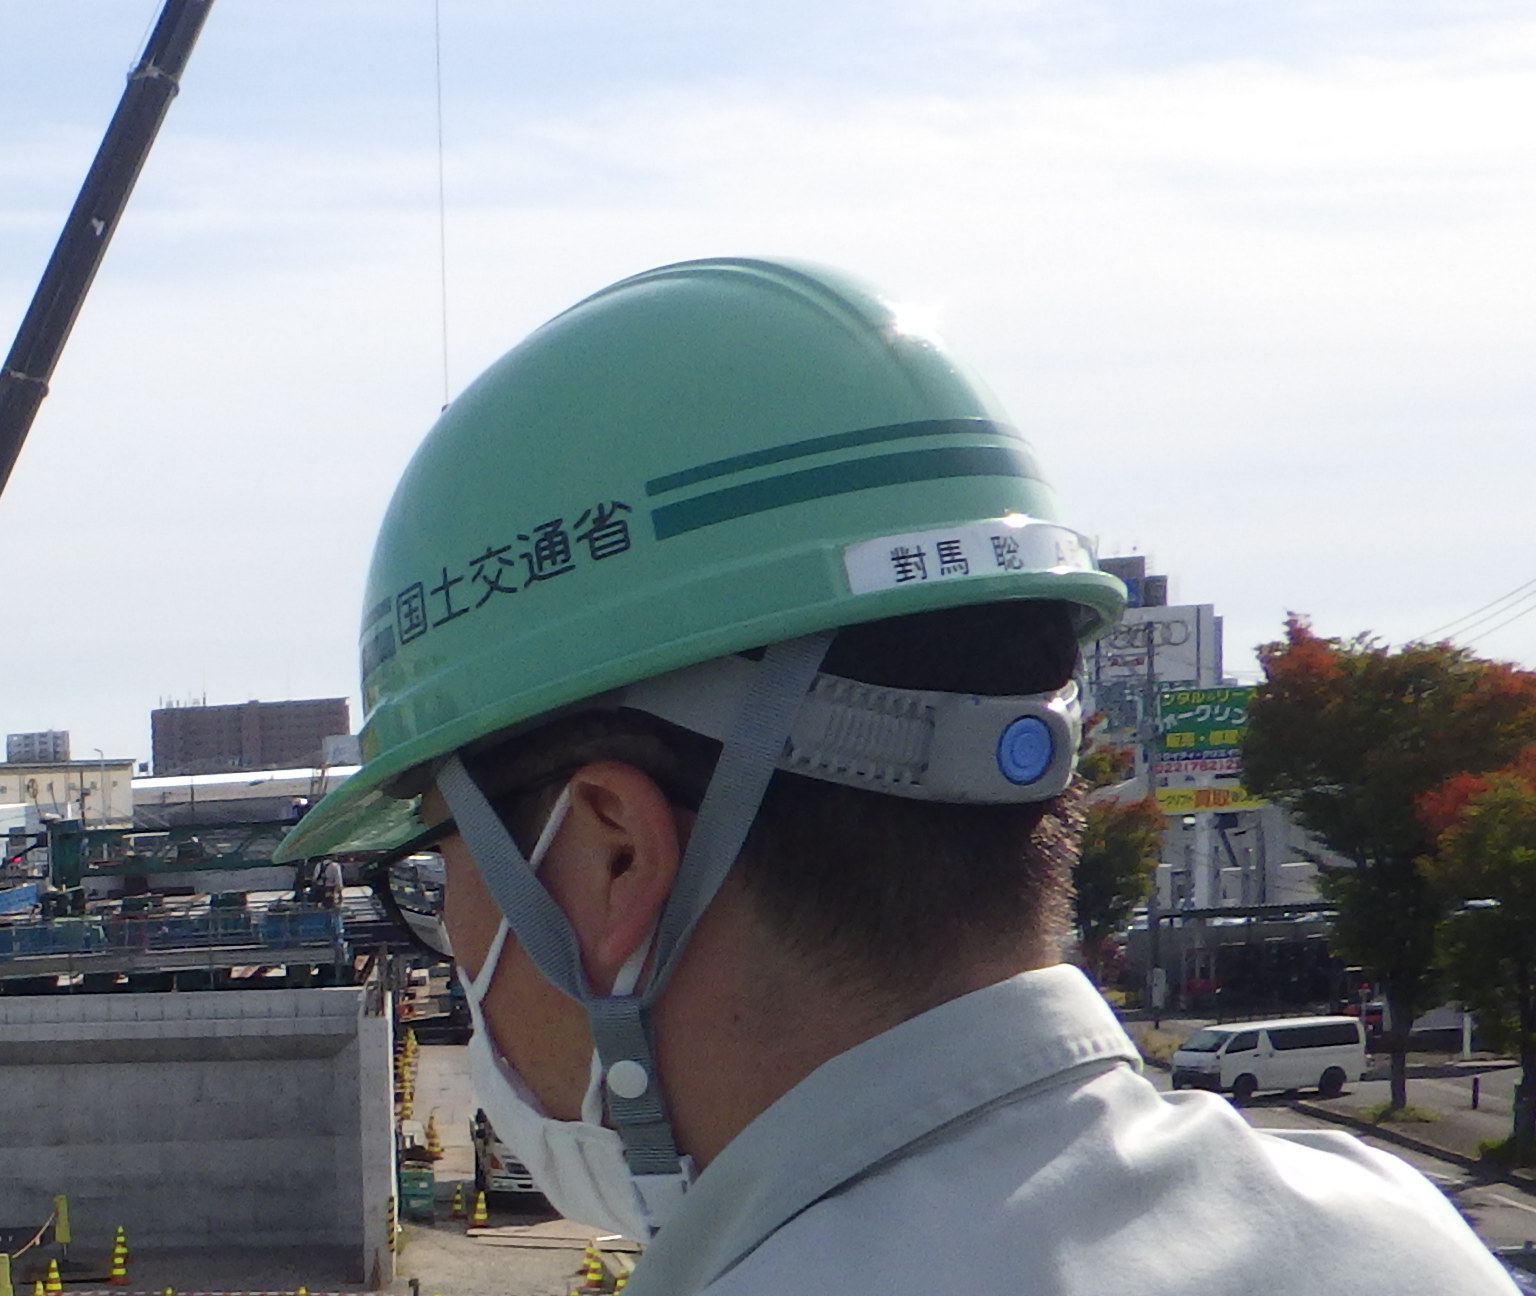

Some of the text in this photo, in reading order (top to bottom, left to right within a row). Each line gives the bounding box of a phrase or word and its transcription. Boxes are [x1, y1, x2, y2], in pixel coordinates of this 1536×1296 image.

[397, 501, 632, 645] 国土交通省
